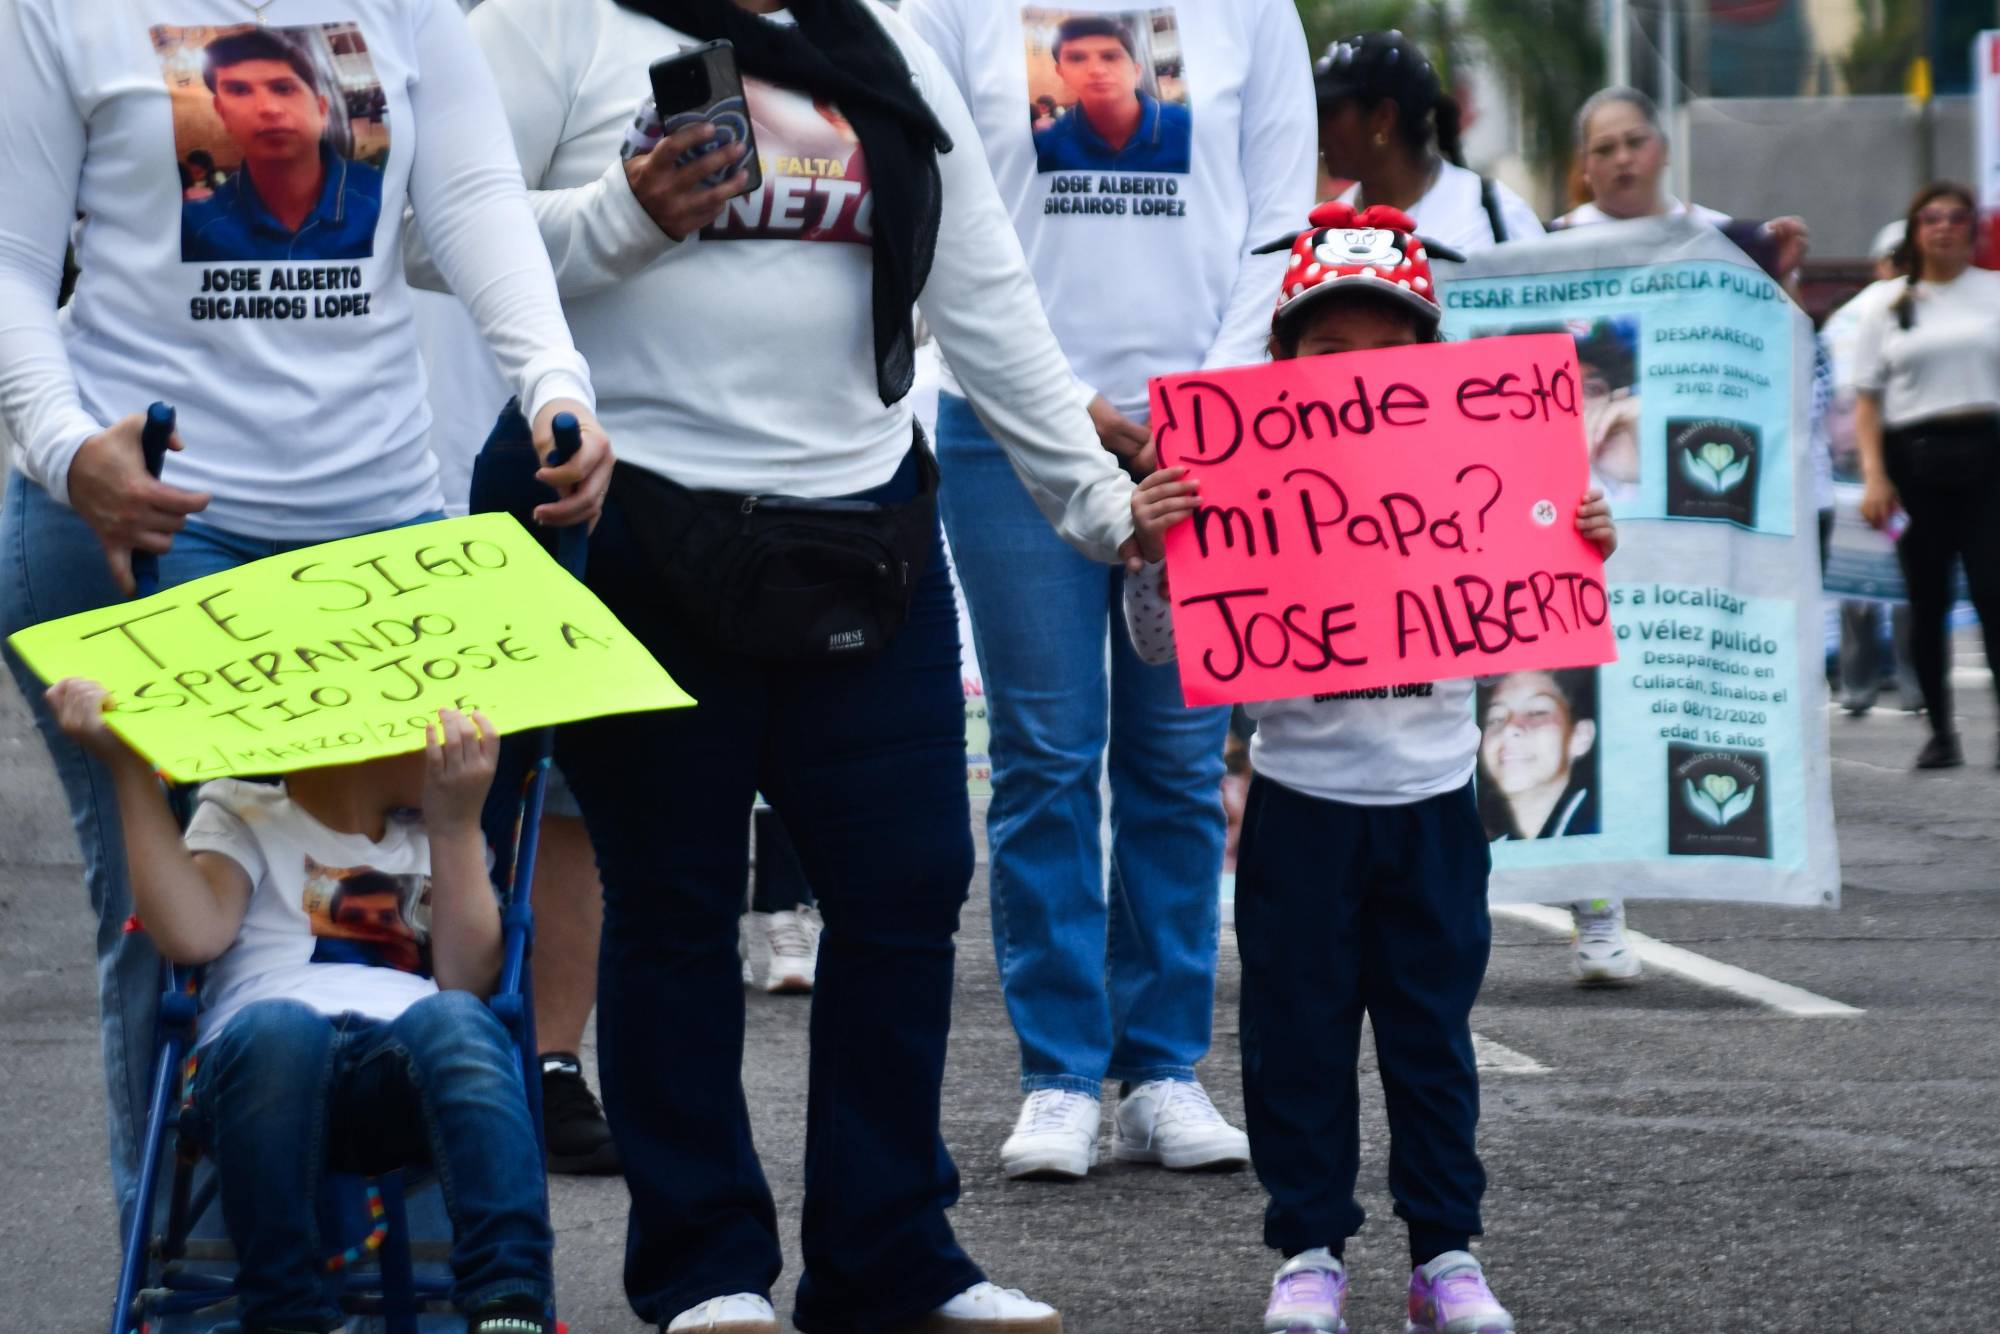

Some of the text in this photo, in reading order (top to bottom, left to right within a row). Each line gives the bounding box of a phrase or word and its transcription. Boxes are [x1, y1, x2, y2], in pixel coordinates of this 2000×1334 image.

[775, 156, 845, 177] FALTA
[1051, 175, 1178, 196] JOSE ALBERTO
[1044, 197, 1186, 216] SICAIROS LOPEZ
[201, 266, 362, 292] JOSE ALBERTO
[1447, 287, 1514, 309] CESAR
[1522, 278, 1622, 304] ERNESTO
[1630, 271, 1714, 295] GARCIA
[190, 292, 372, 320] SICAIROS LOPEZ
[1648, 362, 1719, 377] CULIACAN
[1456, 361, 1578, 422] está
[1191, 488, 1280, 558] mi
[80, 540, 508, 670] TE SIGO
[1632, 589, 1646, 605] a
[1655, 583, 1747, 616] localizar
[1180, 571, 1609, 682] JOSE ALBERTO
[1638, 619, 1704, 641] Vélez
[1711, 627, 1778, 655] pulido
[1644, 650, 1775, 679] Desaparecido en
[1392, 682, 1434, 698] LOPEZ
[1711, 681, 1768, 701] Sinaloa
[1772, 688, 1788, 703] el
[208, 685, 352, 732] TIO
[1683, 700, 1767, 725] 08/12/2020
[1660, 723, 1765, 747] edad 16 años
